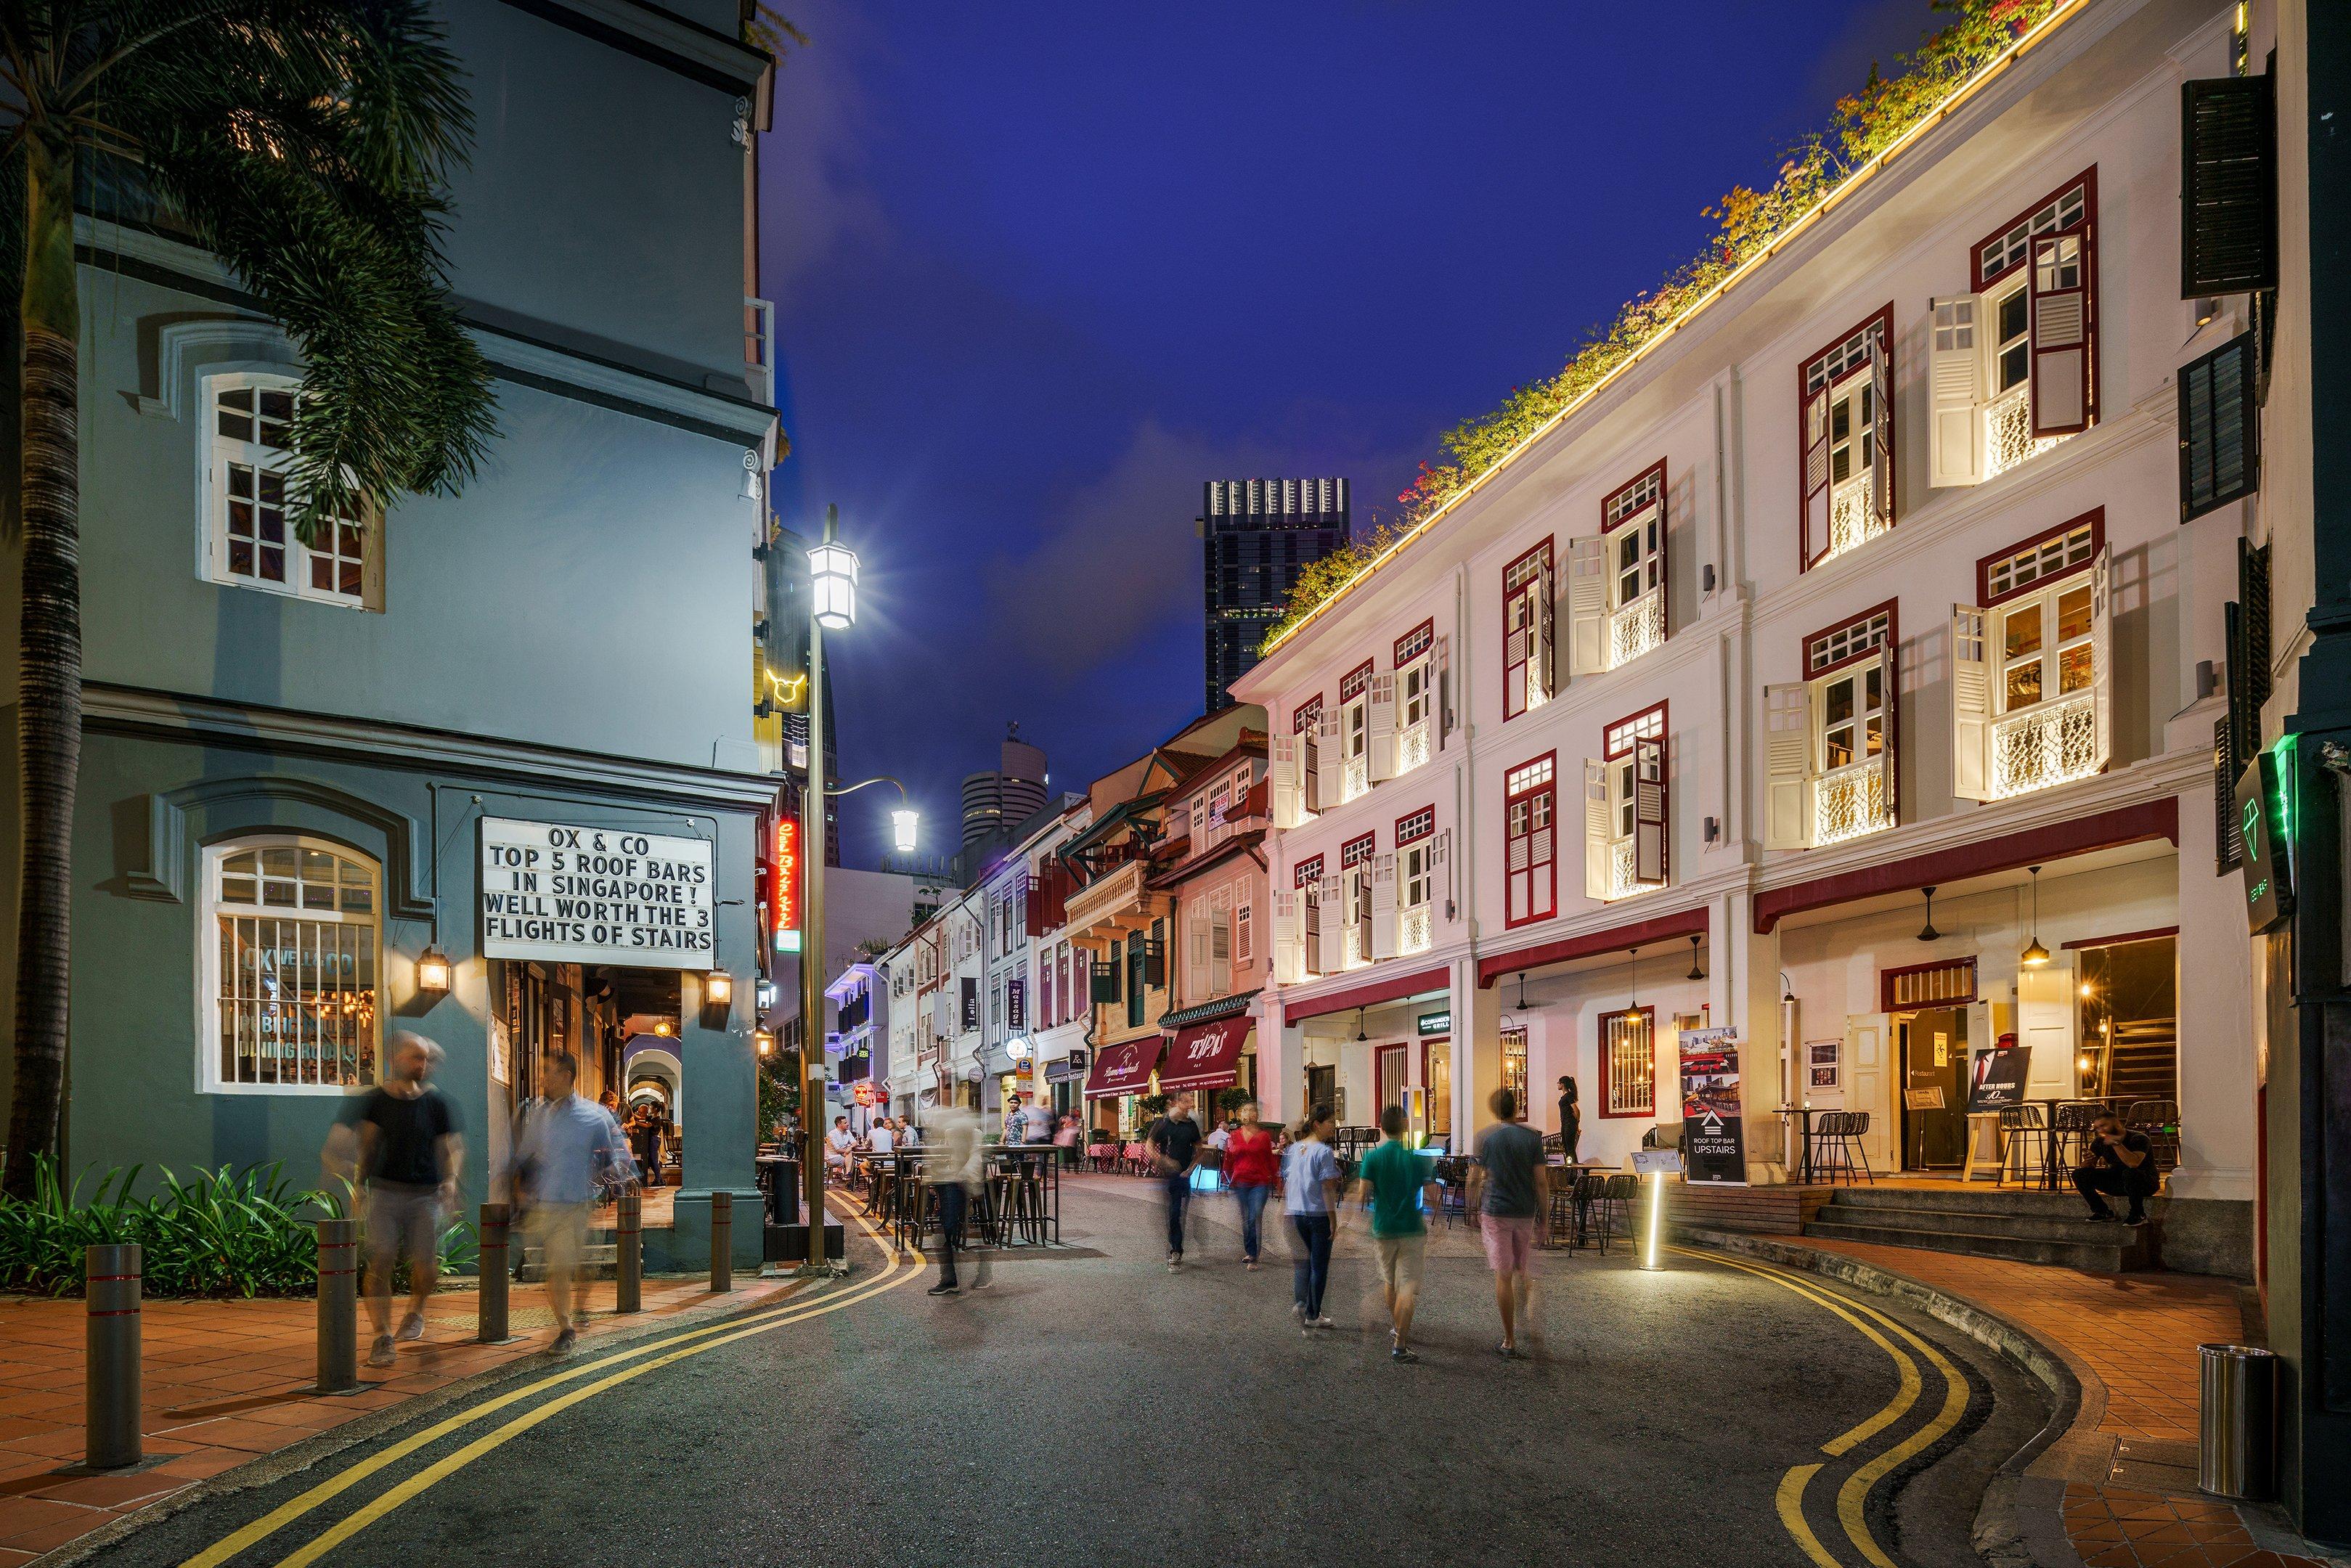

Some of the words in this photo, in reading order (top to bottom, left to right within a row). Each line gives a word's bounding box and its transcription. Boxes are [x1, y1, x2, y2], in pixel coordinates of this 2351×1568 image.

[548, 828, 581, 849] OX
[592, 832, 607, 852] &
[620, 836, 649, 856] CO
[489, 845, 539, 868] TOP
[552, 851, 565, 871] 5
[576, 853, 637, 877] ROOF
[646, 860, 705, 883] BARS
[513, 871, 537, 892] IN
[483, 893, 549, 917] WELL
[555, 898, 638, 923] WORTH
[644, 905, 686, 926] THE
[697, 909, 709, 928] 3
[486, 917, 586, 942] FLIGHTS
[592, 924, 623, 944] OF
[631, 926, 712, 950] STAIRS
[244, 947, 312, 971] OXWEL
[1011, 989, 1021, 1024] Massage
[1048, 1074, 1068, 1084] Indonesian
[1694, 1146, 1736, 1154] UPSTAIRS
